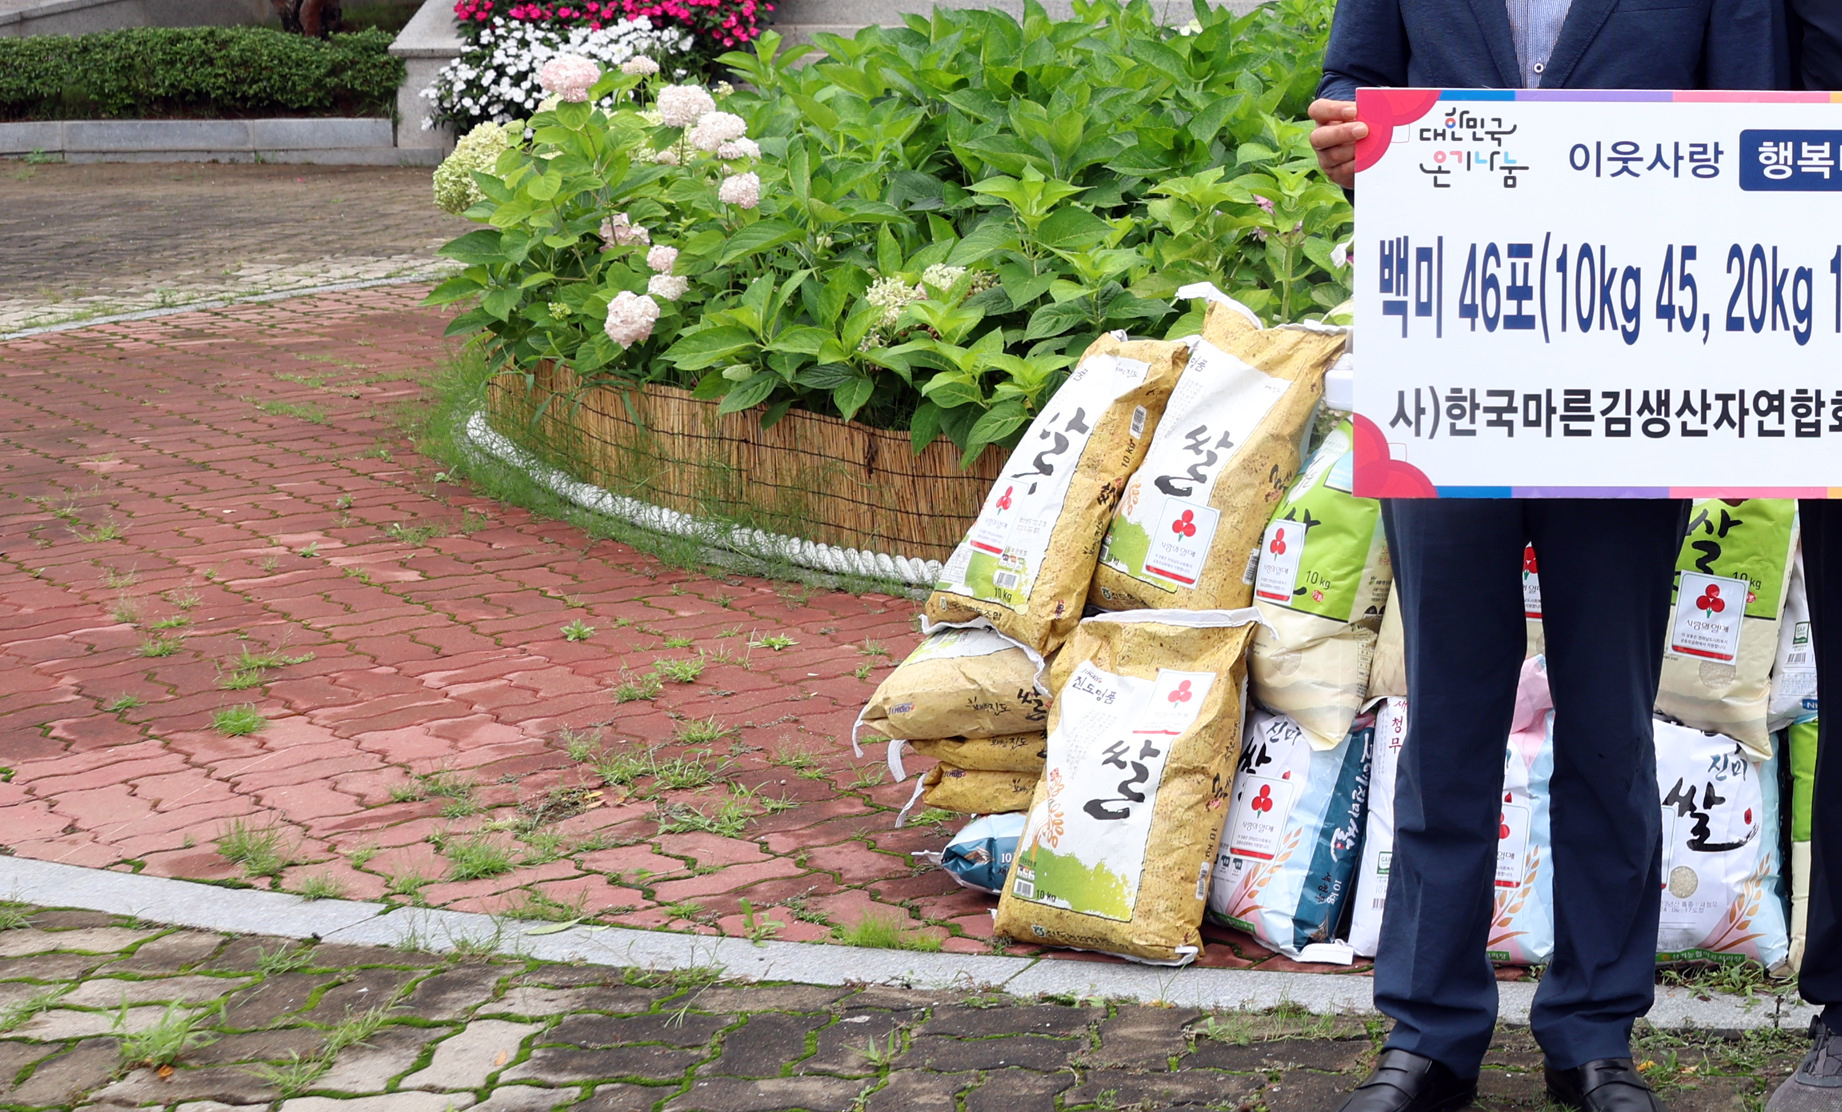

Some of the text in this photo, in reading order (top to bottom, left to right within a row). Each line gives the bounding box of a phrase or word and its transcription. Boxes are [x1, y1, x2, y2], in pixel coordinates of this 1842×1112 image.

[1420, 107, 1517, 147] 대한민국
[1419, 150, 1529, 188] 온기나눔
[1570, 141, 1723, 178] 이웃사랑
[1380, 236, 1442, 337] 백미
[1459, 232, 1640, 345] 46포(10kg
[1656, 245, 1709, 344] 45,
[1726, 244, 1812, 345] 20kg
[1154, 425, 1234, 497] 쌀
[1002, 588, 1012, 602] kg
[1306, 570, 1331, 590] 10 kg
[1750, 578, 1761, 590] kg
[1072, 676, 1117, 705] 진도명품
[1083, 739, 1161, 820] 쌀
[1708, 754, 1747, 780] 진미
[1662, 777, 1759, 853] 쌀
[1036, 889, 1045, 899] 10
[1327, 879, 1342, 906] 10 kg
